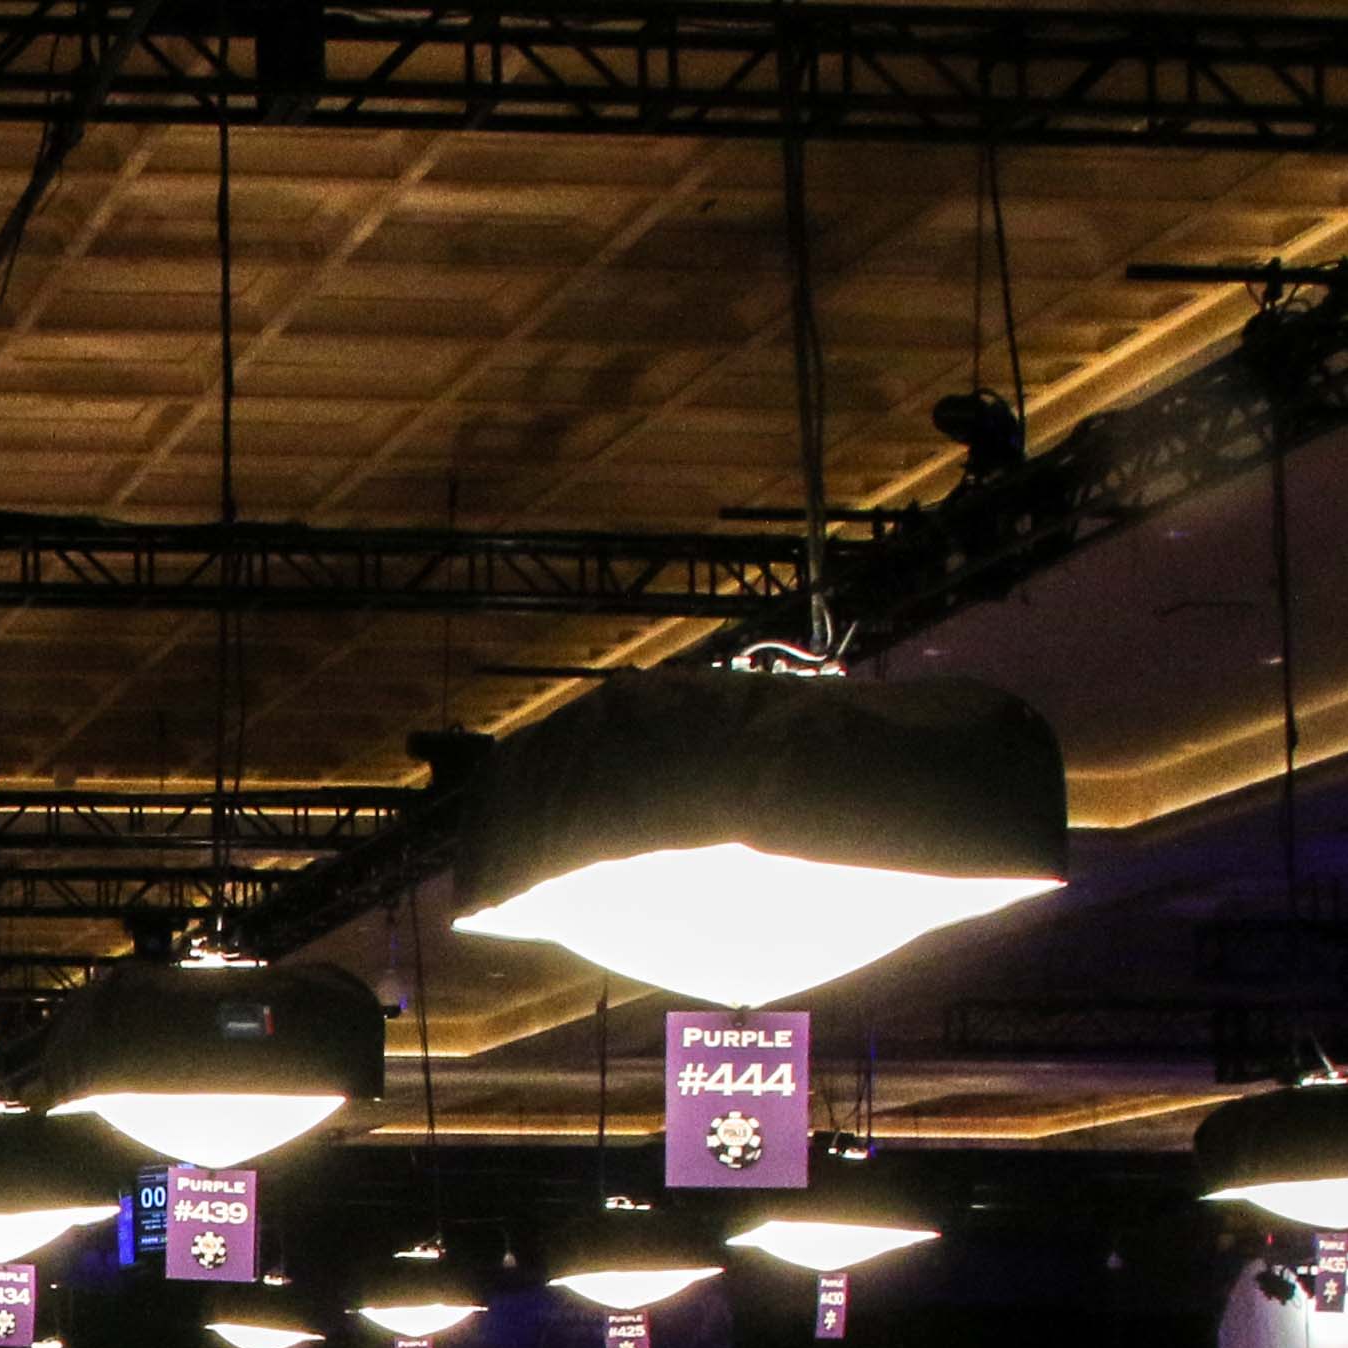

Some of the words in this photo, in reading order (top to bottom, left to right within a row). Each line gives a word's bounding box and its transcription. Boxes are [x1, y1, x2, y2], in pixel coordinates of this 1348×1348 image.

[682, 1027, 793, 1048] PURPLE
[677, 1062, 796, 1097] #444
[177, 1176, 247, 1194] PURPLE
[173, 1199, 248, 1225] #439
[608, 1314, 643, 1323] PURPLE
[608, 1325, 646, 1338] #425
